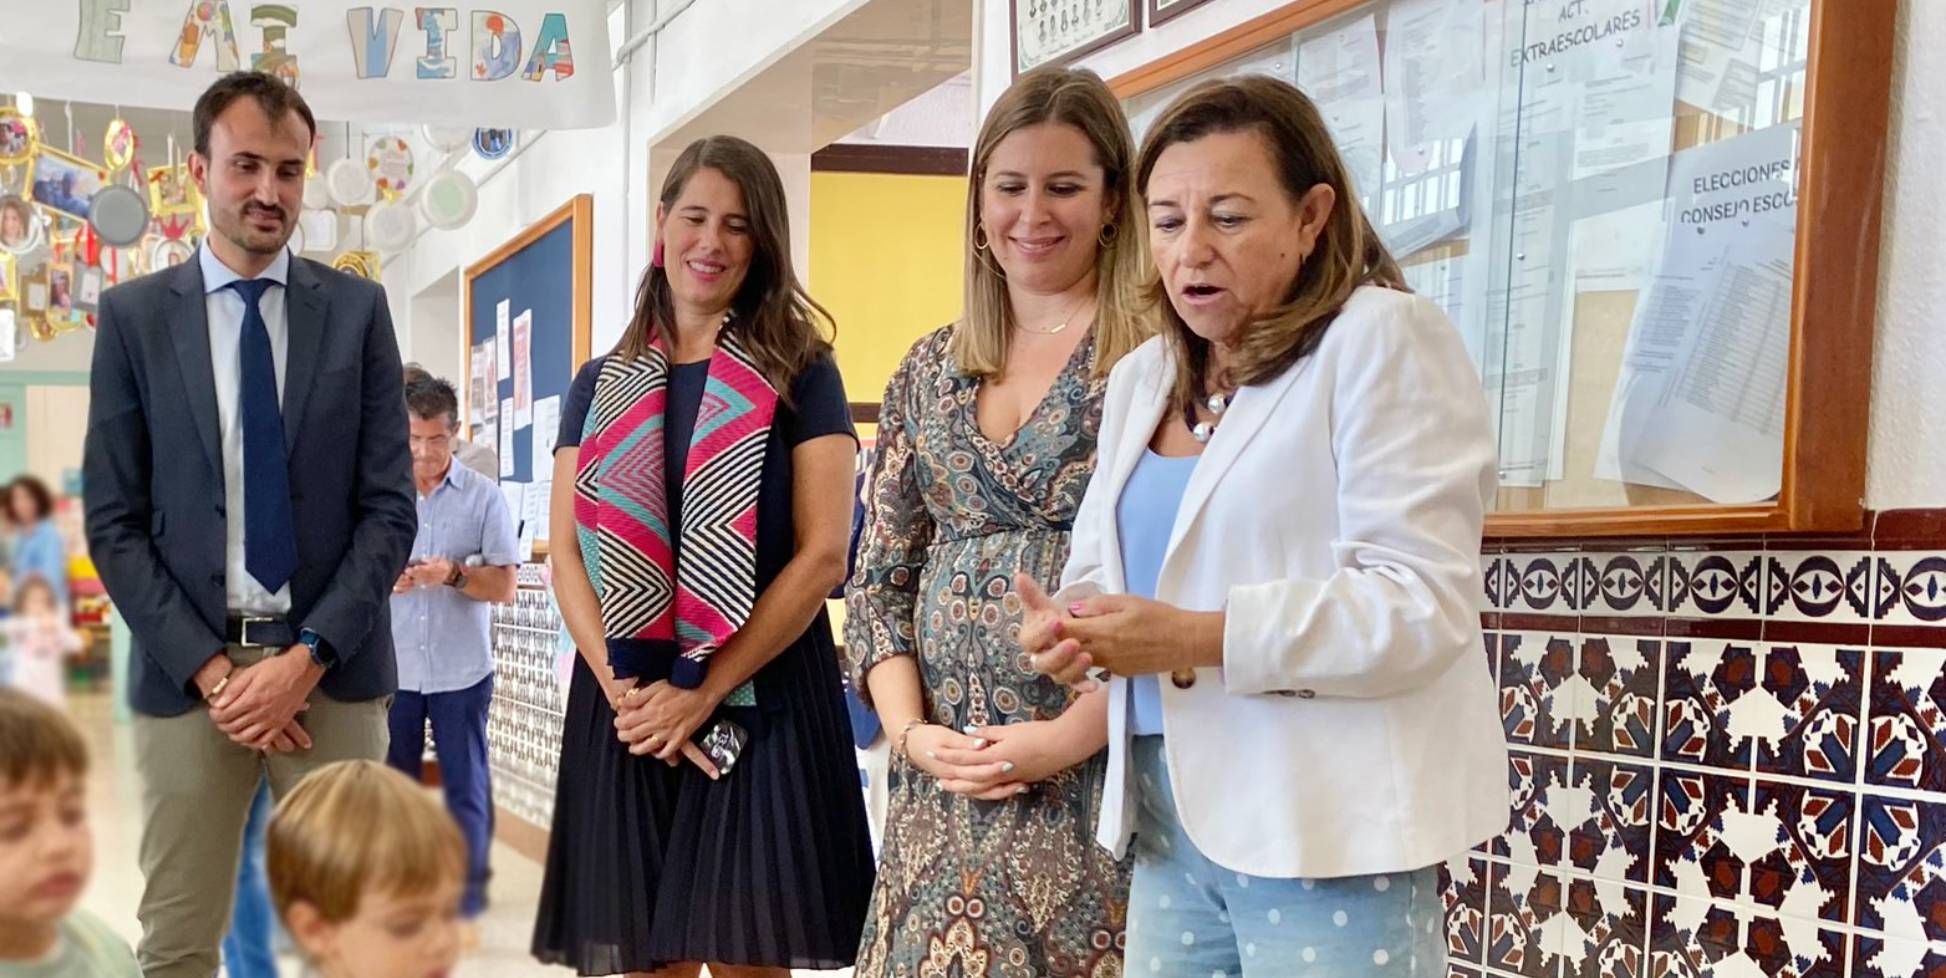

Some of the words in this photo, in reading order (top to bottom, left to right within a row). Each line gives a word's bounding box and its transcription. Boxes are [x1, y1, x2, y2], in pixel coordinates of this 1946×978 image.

[1558, 0, 1589, 23] ACT.
[168, 0, 299, 89] MI
[347, 7, 574, 82] VIDA
[1511, 9, 1641, 68] EXTRAESCOLARES
[1693, 159, 1791, 194] ELECCIONES
[1680, 199, 1750, 224] CONSEJO
